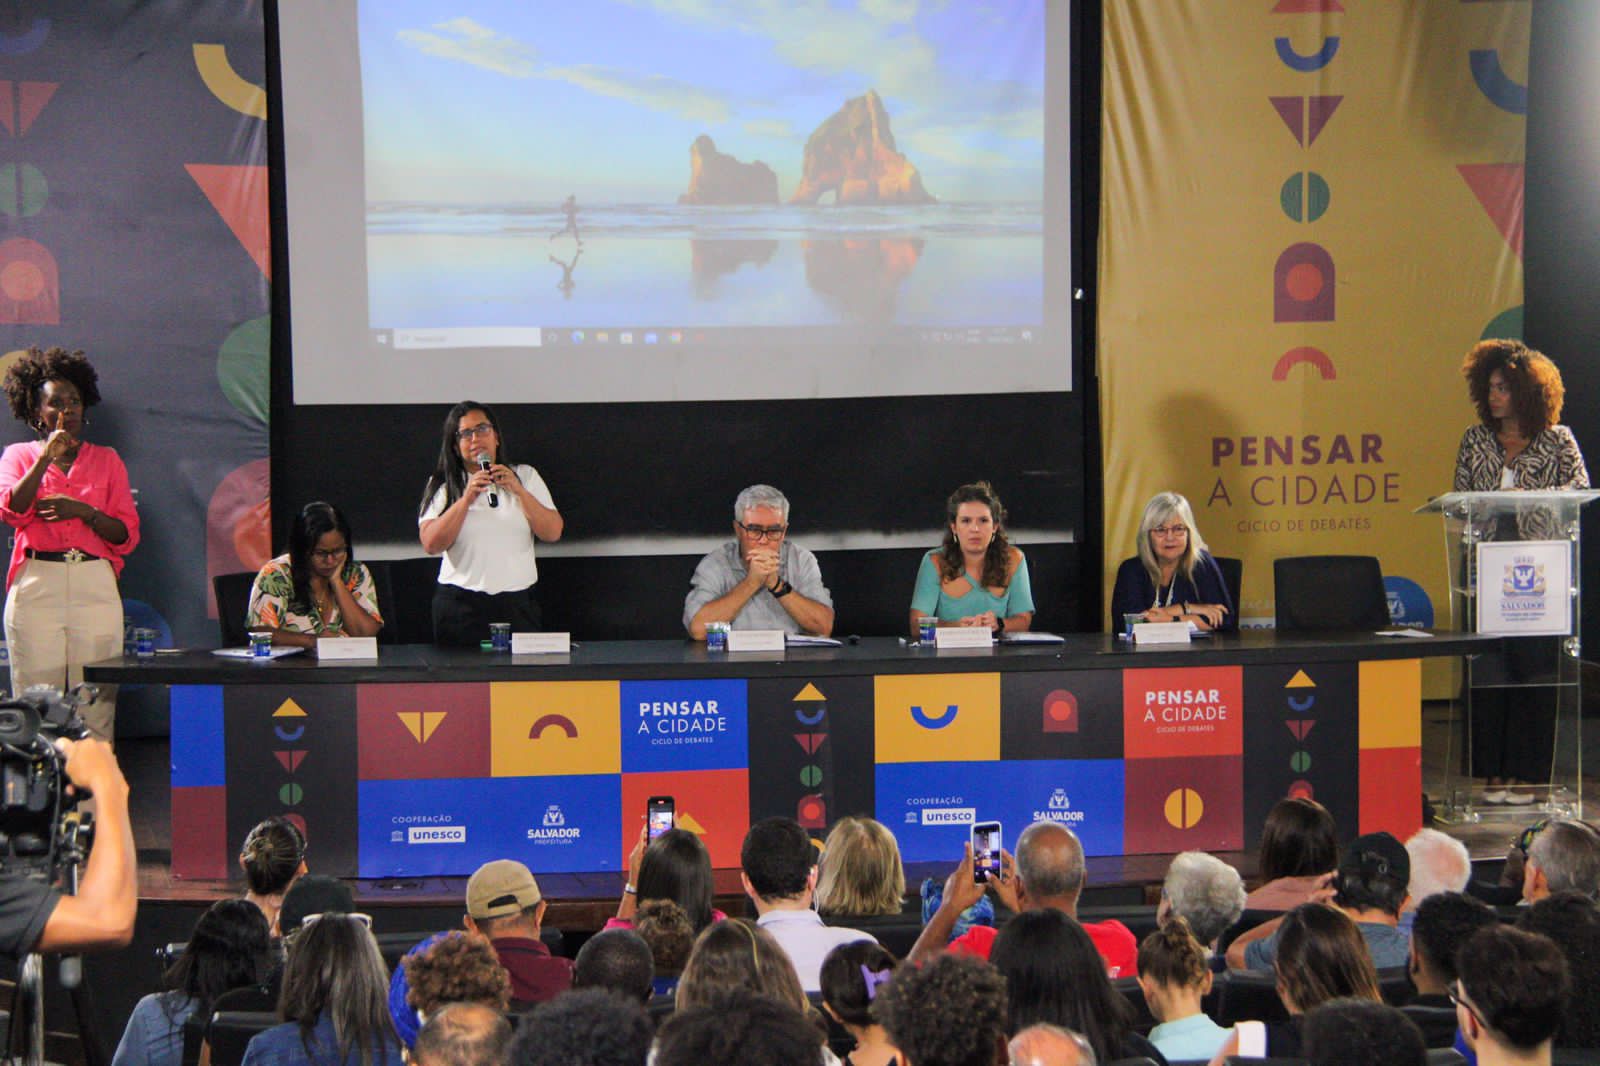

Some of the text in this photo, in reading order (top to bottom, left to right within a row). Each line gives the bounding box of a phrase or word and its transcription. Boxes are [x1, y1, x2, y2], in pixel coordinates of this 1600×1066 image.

[1212, 433, 1384, 467] PENSAR
[1207, 472, 1400, 507] A CIDADE
[1237, 517, 1371, 533] CICLO DE DEBATES
[1145, 689, 1220, 705] PENSAR
[639, 700, 719, 717] PENSAR
[1143, 706, 1227, 722] A CIDADE
[637, 717, 727, 734] A CIDADE
[684, 736, 713, 744] DEBATES
[906, 797, 963, 805] COOPERAÇÃO
[391, 815, 452, 824] COOPERAÇÃO
[926, 812, 972, 821] unesco
[1033, 811, 1084, 821] SALVADOR
[413, 831, 462, 840] unesco
[527, 828, 580, 839] SALVADOR
